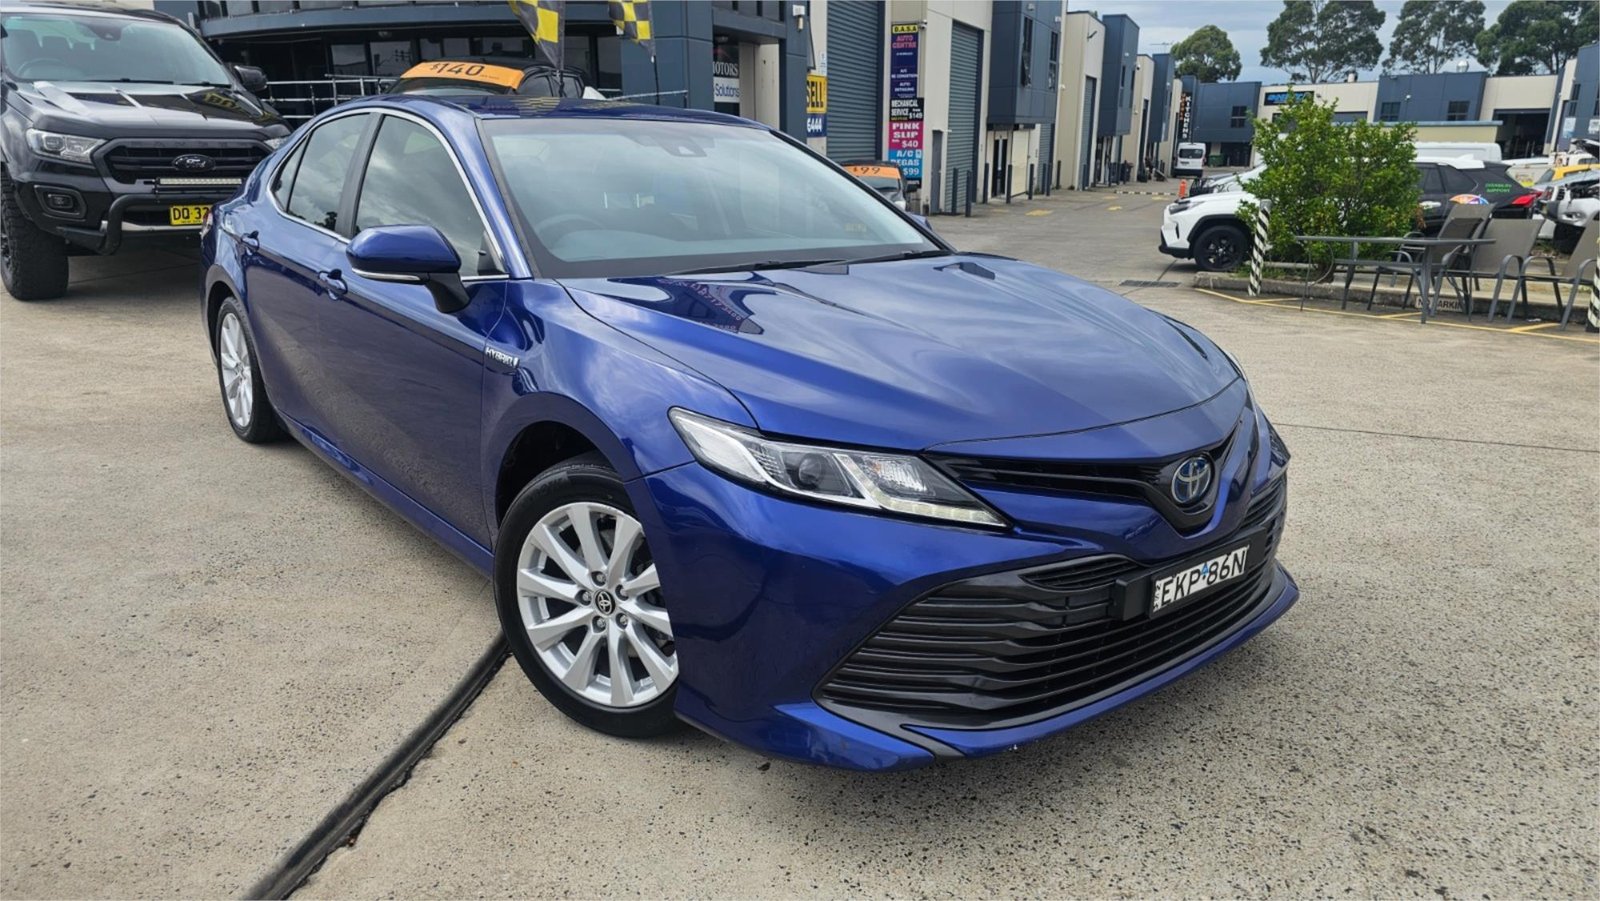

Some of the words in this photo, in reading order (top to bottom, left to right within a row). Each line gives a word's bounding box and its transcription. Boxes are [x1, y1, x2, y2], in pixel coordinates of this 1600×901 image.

[430, 62, 485, 76] $140
[714, 83, 740, 98] Solutions
[892, 122, 920, 130] PINK
[893, 131, 919, 139] SLIP
[902, 140, 919, 149] $40
[903, 167, 920, 176] $99
[485, 346, 513, 366] HYBRID
